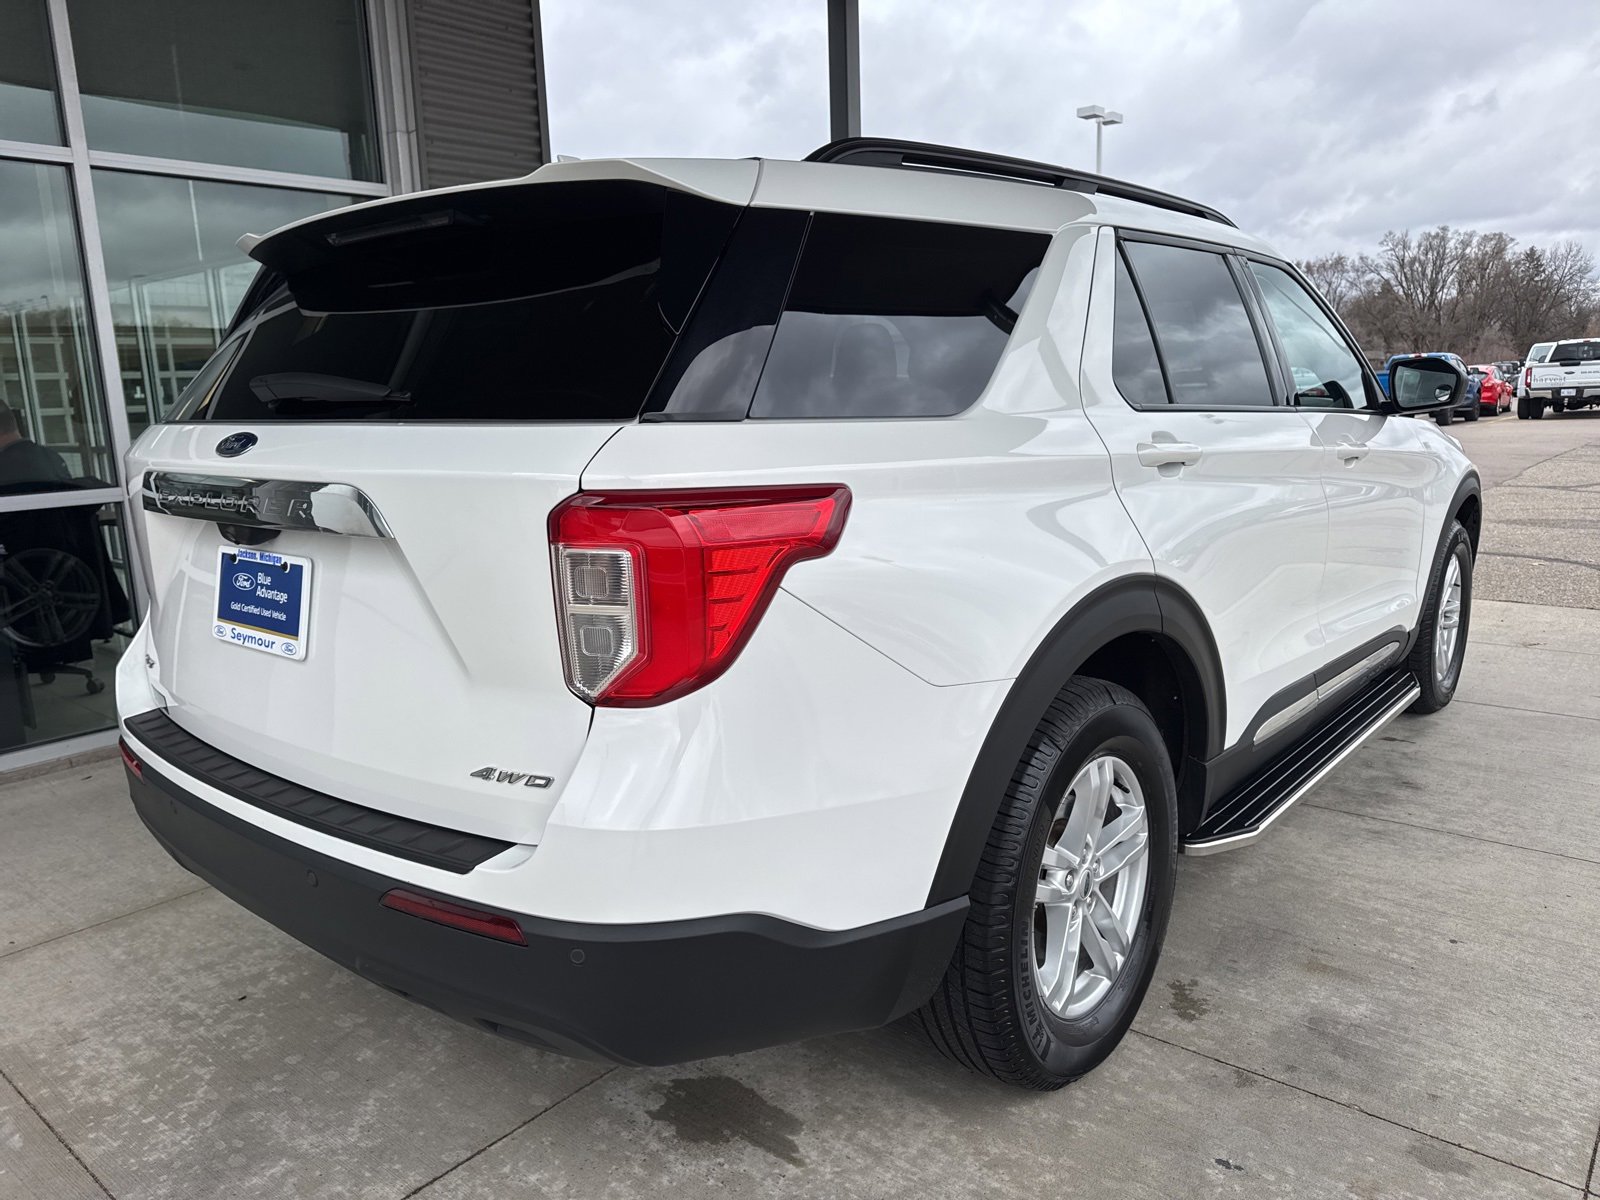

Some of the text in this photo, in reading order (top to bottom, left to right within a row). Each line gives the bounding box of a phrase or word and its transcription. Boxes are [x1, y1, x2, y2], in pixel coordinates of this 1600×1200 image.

[157, 488, 308, 519] EXPLORER
[260, 551, 282, 565] Michigan
[257, 572, 271, 586] Blue
[256, 585, 288, 604] Advantage
[230, 601, 287, 621] Gold Certified Used Vehicle
[230, 627, 275, 649] Seymour
[470, 767, 555, 789] 4WD
[1020, 920, 1037, 1026] MICHELIN
